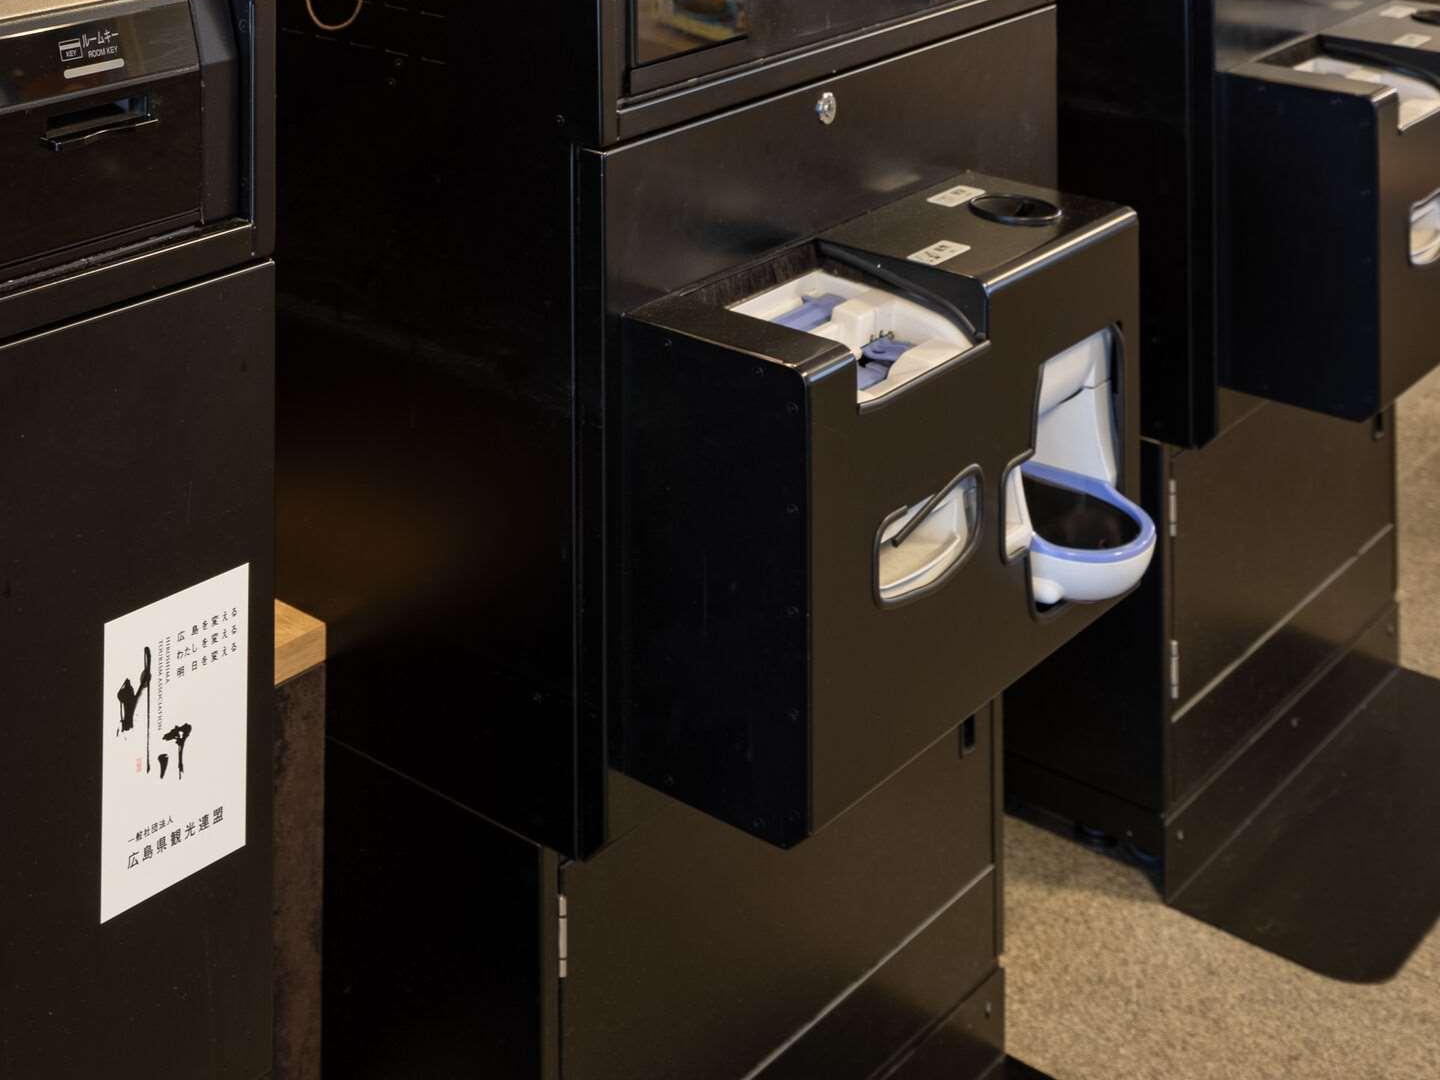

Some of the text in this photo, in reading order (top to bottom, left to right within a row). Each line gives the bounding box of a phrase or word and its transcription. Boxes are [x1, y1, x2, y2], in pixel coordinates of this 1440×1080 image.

[81, 29, 120, 49] ルームキー
[87, 45, 119, 59] ROOM KEY
[65, 49, 77, 58] KEY
[157, 640, 165, 677] TOURISM
[164, 636, 172, 684] HIROSHIMA
[127, 816, 174, 843] 一般社団法人
[127, 806, 224, 870] 広島県観光連盟
